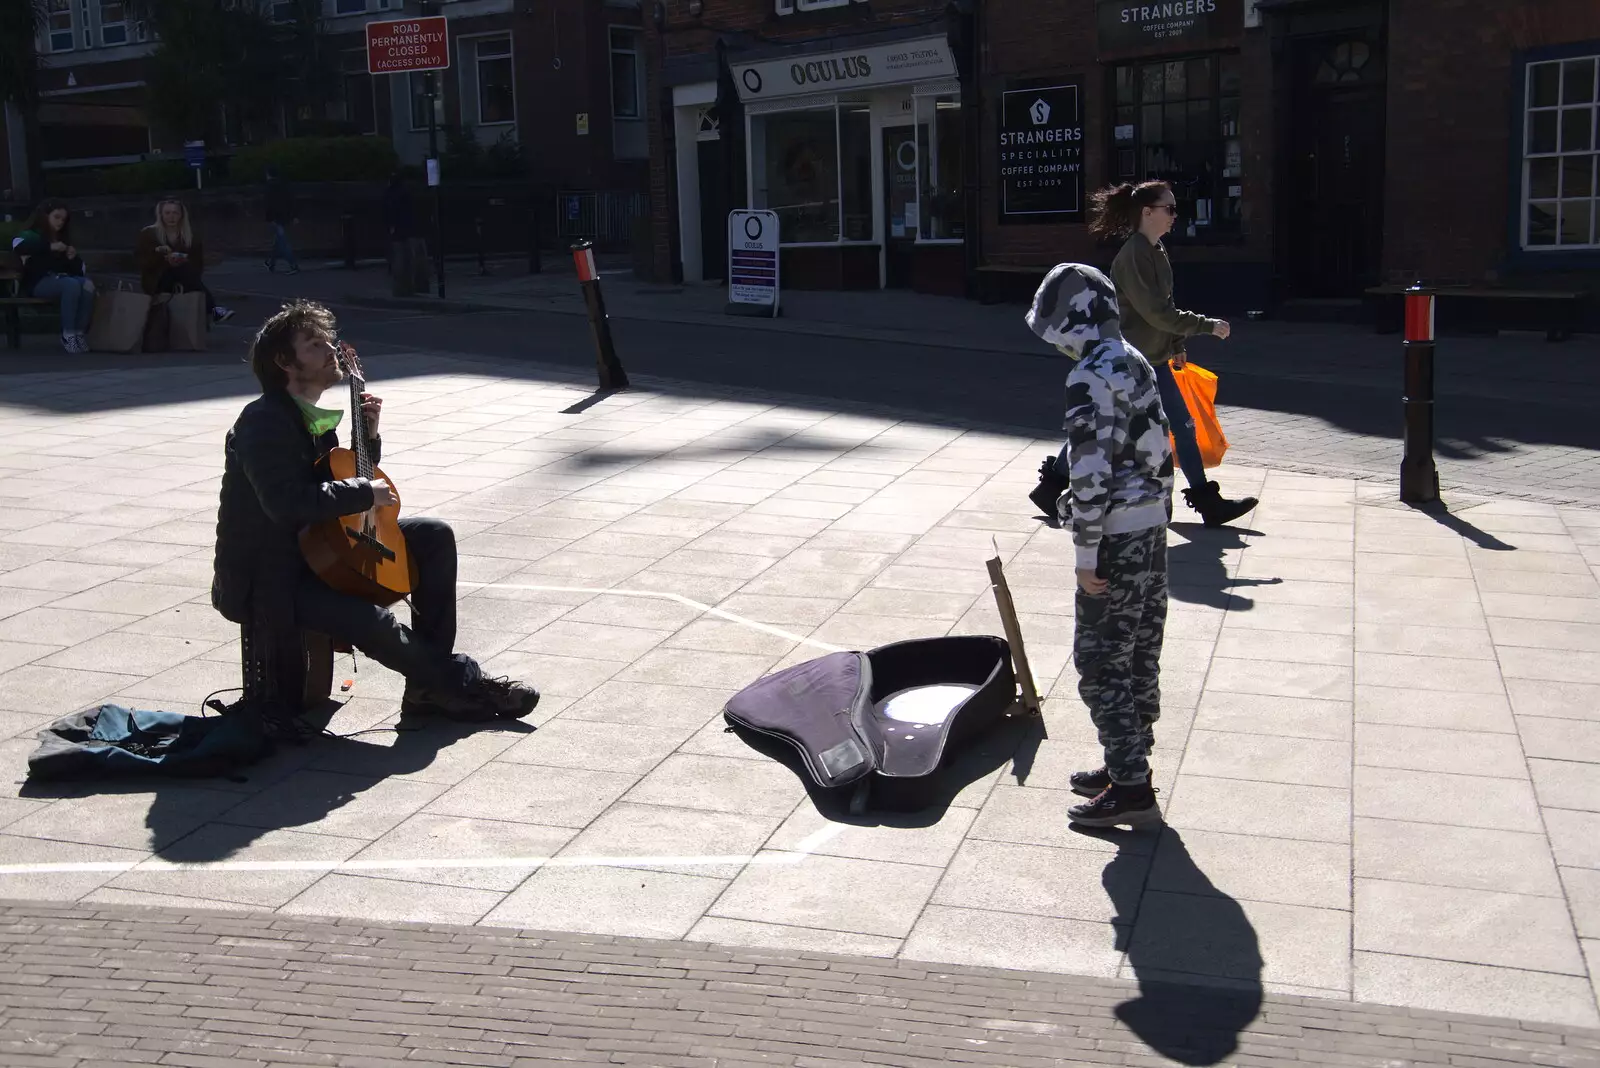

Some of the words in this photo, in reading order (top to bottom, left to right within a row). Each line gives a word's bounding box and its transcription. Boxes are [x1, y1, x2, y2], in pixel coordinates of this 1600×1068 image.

[1121, 0, 1216, 23] STRANGERS
[393, 23, 420, 35] ROAD
[1142, 23, 1165, 32] COFFEE
[1166, 20, 1194, 29] COMPANY
[371, 32, 443, 47] PERMANENTLY
[388, 45, 428, 57] CLOSED
[377, 58, 413, 69] (ACCESS
[415, 55, 441, 66] ONLY)
[790, 55, 871, 85] OCULUS
[1036, 103, 1044, 122] S
[1000, 127, 1082, 146] STRANGERS
[1001, 147, 1080, 161] SPECIALITY
[1001, 165, 1034, 175] COFFEE
[1038, 163, 1080, 174] COMPANY
[1016, 180, 1033, 188] EST
[1038, 178, 1062, 187] 2009
